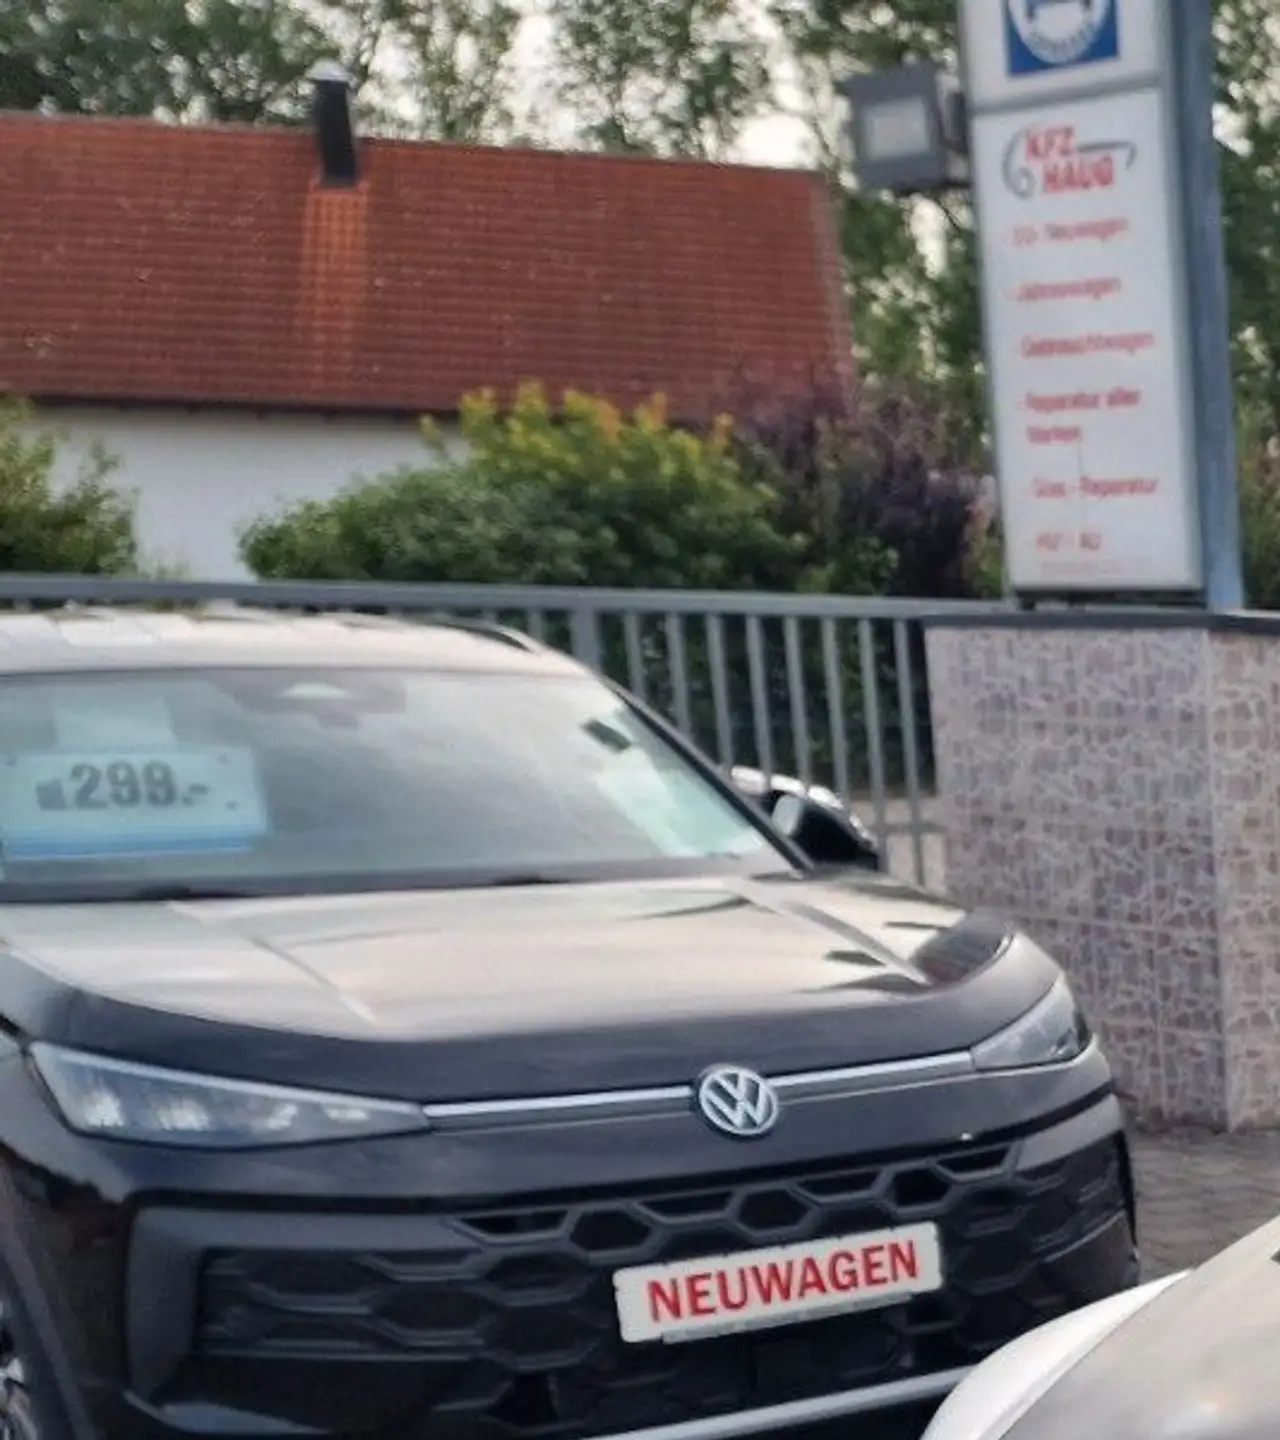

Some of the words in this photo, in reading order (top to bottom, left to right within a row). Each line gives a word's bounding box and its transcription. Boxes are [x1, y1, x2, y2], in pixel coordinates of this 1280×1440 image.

[1025, 125, 1075, 162] KFZ
[1043, 154, 1116, 195] HAUG
[646, 1239, 920, 1323] NEUWAGEN
